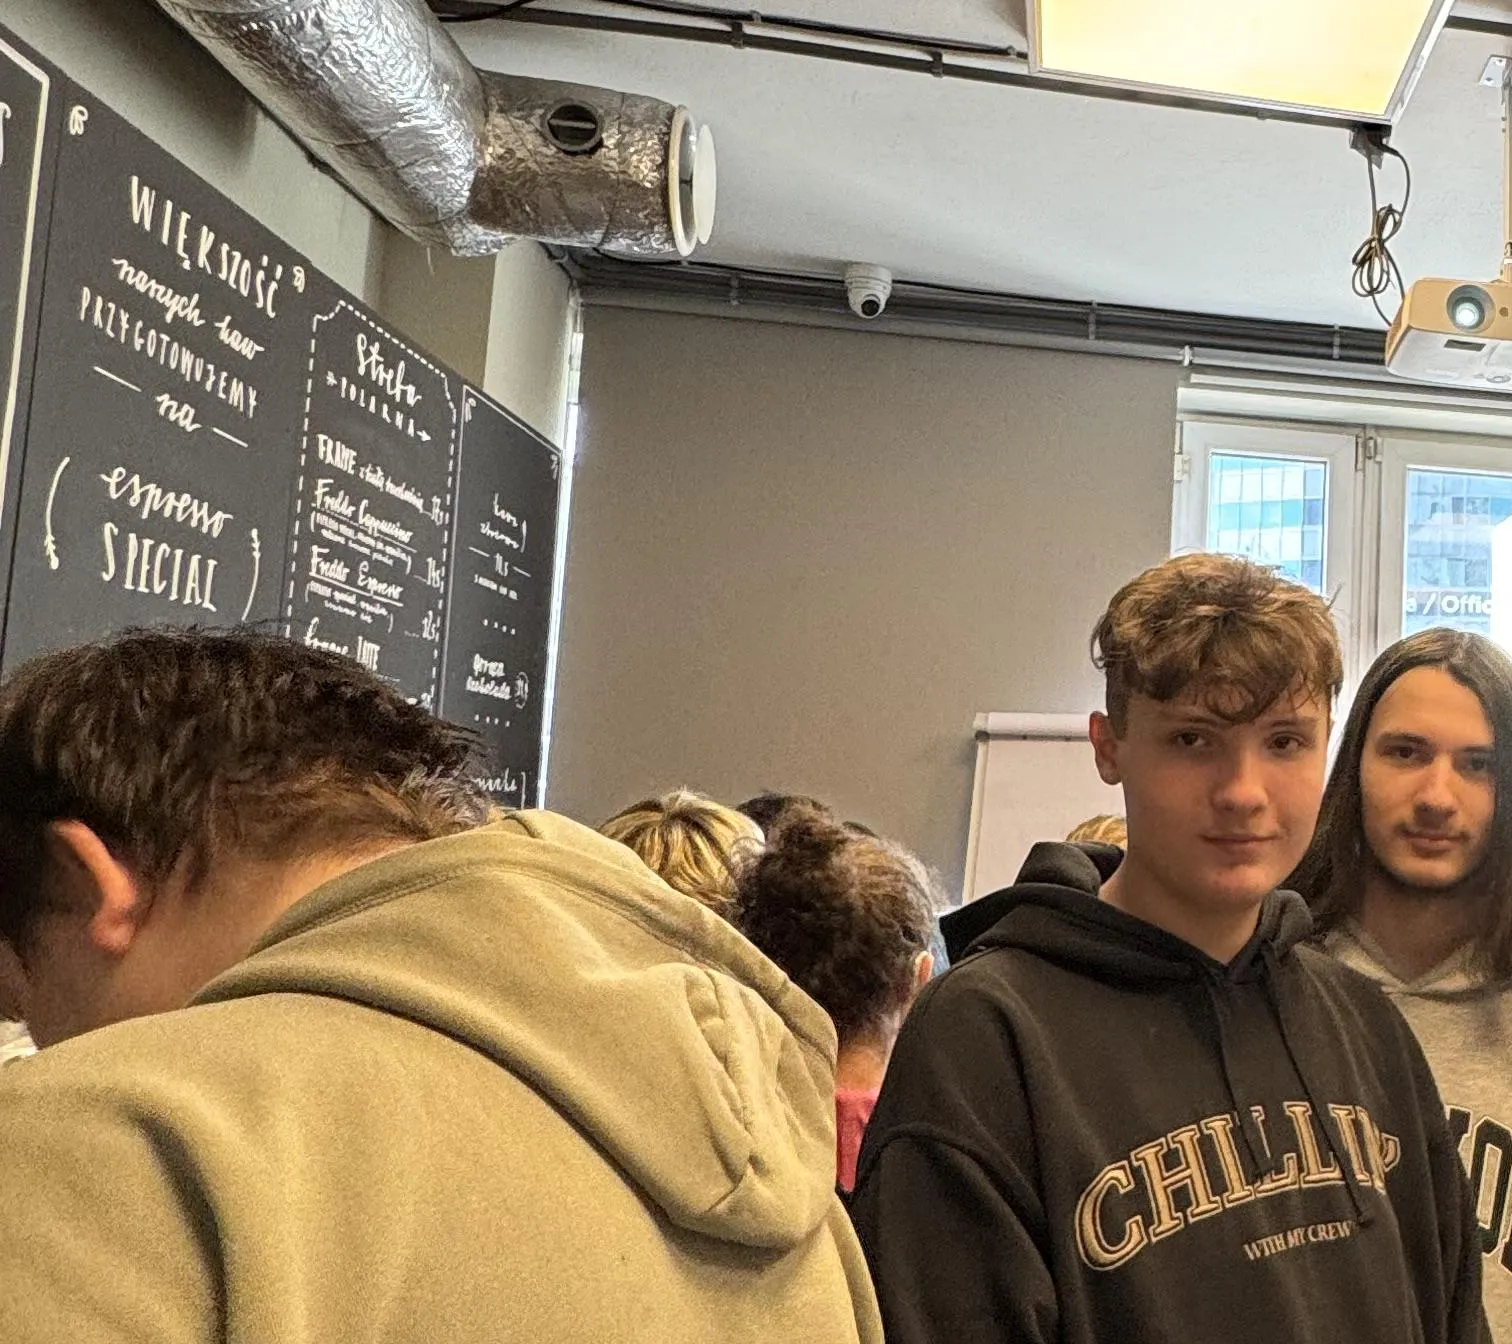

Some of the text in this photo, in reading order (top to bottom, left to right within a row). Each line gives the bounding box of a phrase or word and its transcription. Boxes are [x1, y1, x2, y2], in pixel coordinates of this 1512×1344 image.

[131, 175, 282, 319] WIĘKSZOŚĆ
[79, 286, 257, 419] PRZYGOTOWUJEMY
[111, 258, 265, 360] naszych kaw
[154, 392, 203, 432] na
[100, 466, 234, 538] espresso
[102, 521, 218, 613] SPECIAL
[1243, 1220, 1355, 1261] WITH MY CREW
